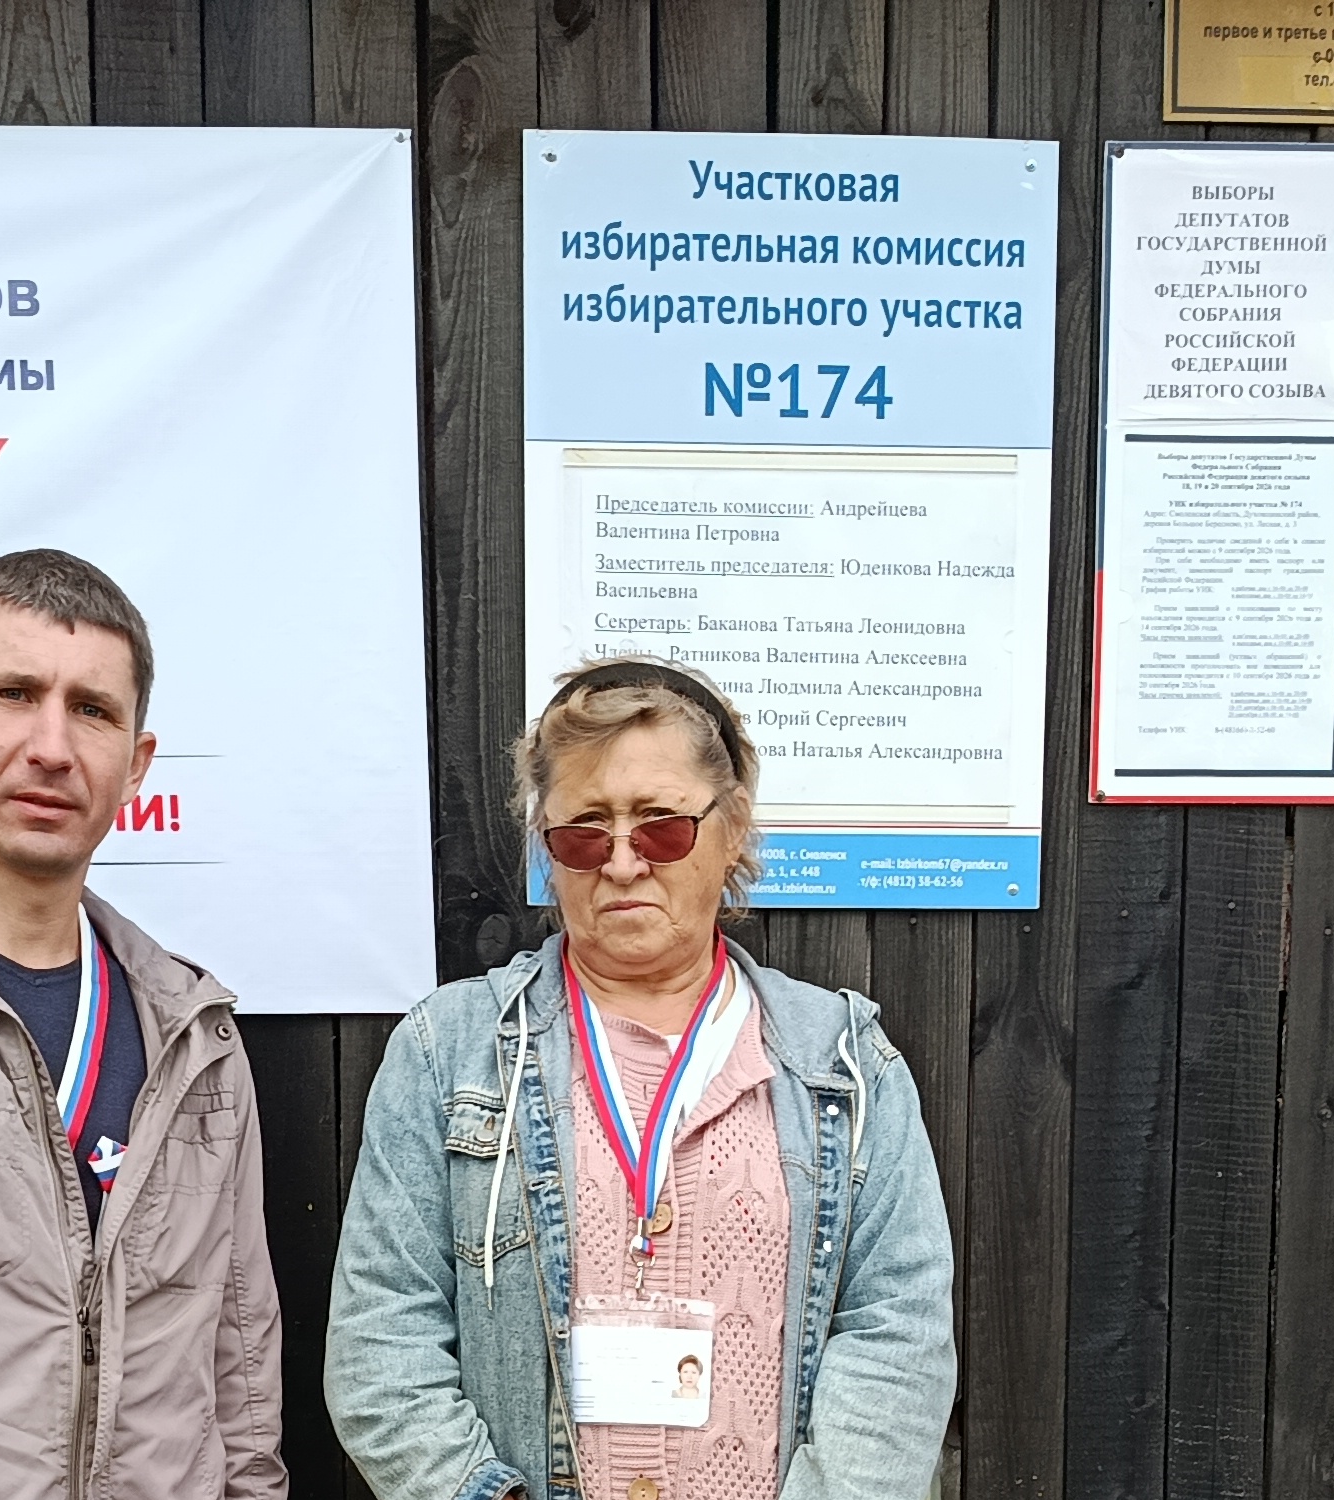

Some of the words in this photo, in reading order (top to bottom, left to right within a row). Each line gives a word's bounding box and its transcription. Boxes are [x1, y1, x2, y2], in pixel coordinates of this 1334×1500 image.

[1314, 5, 1322, 17] с
[1204, 26, 1258, 41] первое
[1263, 27, 1272, 38] и
[1276, 27, 1327, 42] третье
[688, 160, 898, 202] Участковая
[1192, 186, 1274, 200] ВЫБОРЫ
[1174, 213, 1289, 228] ДЕПУТАТОВ
[562, 221, 838, 271] избирательная
[853, 236, 1024, 267] комиссия
[1136, 234, 1326, 252] ГОСУДАРСТВЕННОЙ
[1200, 260, 1261, 276] ДУМЫ
[1155, 284, 1307, 299] ФЕДЕРАЛЬНОГО
[564, 283, 867, 333] избирательного
[880, 299, 1021, 337] участка
[1179, 307, 1281, 321] СОБРАНИЯ
[1165, 331, 1295, 348] РОССИЙСКОЙ
[1171, 358, 1287, 373] ФЕДЕРАЦИИ
[705, 362, 893, 419] №174
[1143, 384, 1243, 400] ДЕВЯТОГО
[1249, 384, 1326, 398] СОЗЫВА
[595, 495, 720, 516] Председатель
[721, 502, 815, 518] комиссии:
[820, 500, 927, 520] Андрейцева
[596, 522, 690, 540] Валентина
[696, 525, 779, 545] Петровна
[595, 553, 708, 575] Заместитель
[711, 561, 835, 578] председателя:
[840, 559, 931, 577] Юденкова
[938, 561, 1015, 579] Надежда
[596, 581, 698, 599] Васильевна
[594, 612, 692, 634] Секретарь:
[698, 615, 778, 632] Баканова
[783, 617, 853, 633] Татьяна
[858, 618, 965, 636] Леонидовна
[667, 646, 760, 662] Ратникова
[766, 648, 860, 664] Валентина
[865, 650, 967, 665] Алексеевна
[758, 678, 842, 695] Людмила
[847, 681, 982, 700] Александровна
[758, 709, 810, 729] Юрий
[816, 710, 906, 731] Сергеевич
[793, 741, 862, 758] Наталья
[868, 743, 1002, 764] Александровна
[801, 866, 820, 877] 448
[861, 858, 895, 869] e-mail:
